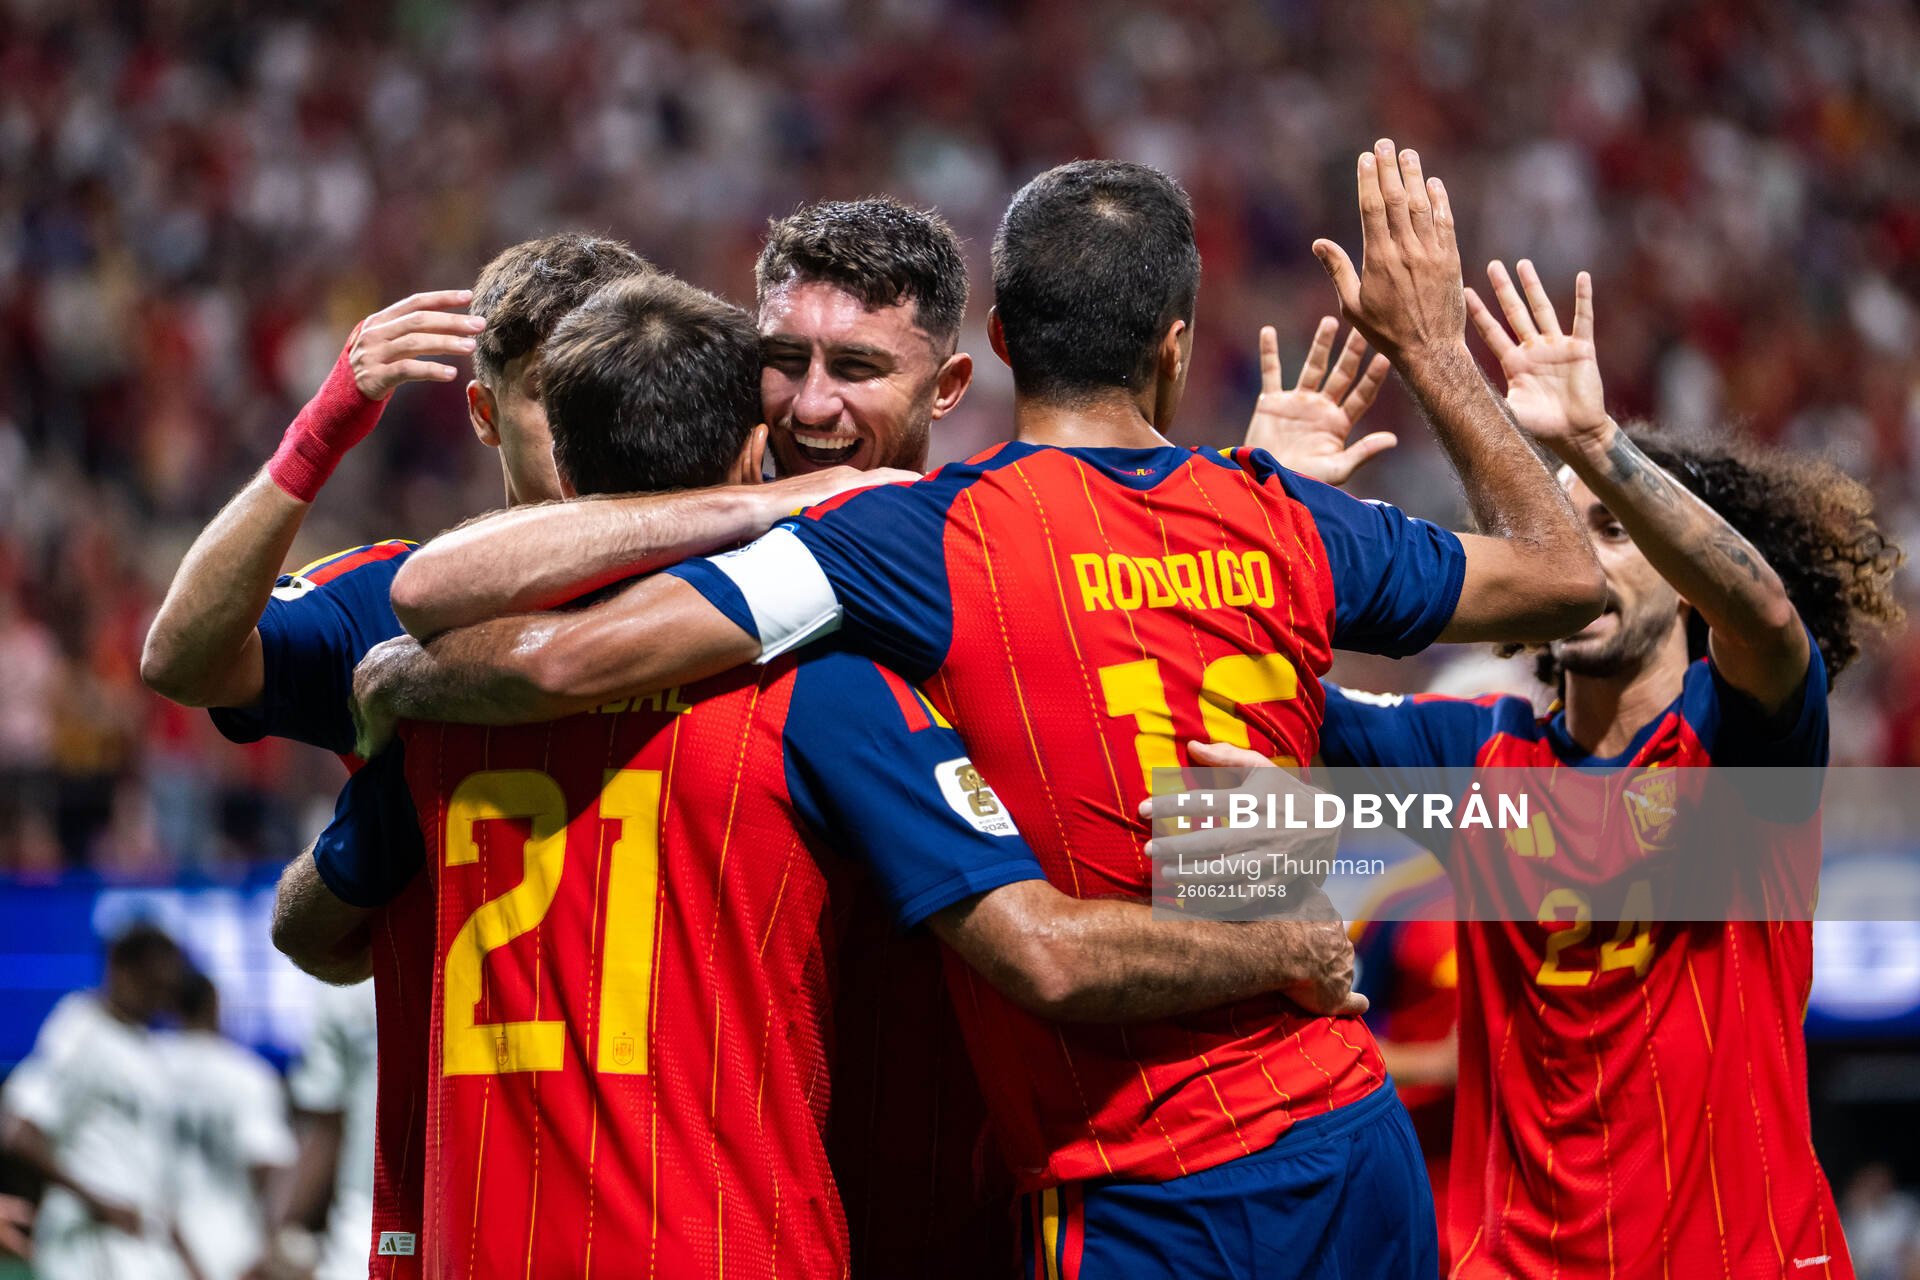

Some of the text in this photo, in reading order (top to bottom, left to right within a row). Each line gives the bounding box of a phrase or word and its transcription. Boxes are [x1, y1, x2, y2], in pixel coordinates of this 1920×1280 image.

[1070, 550, 1276, 612] RODRIGO
[981, 821, 1009, 832] 2026
[442, 768, 663, 1077] 21
[1536, 880, 1655, 986] 24
